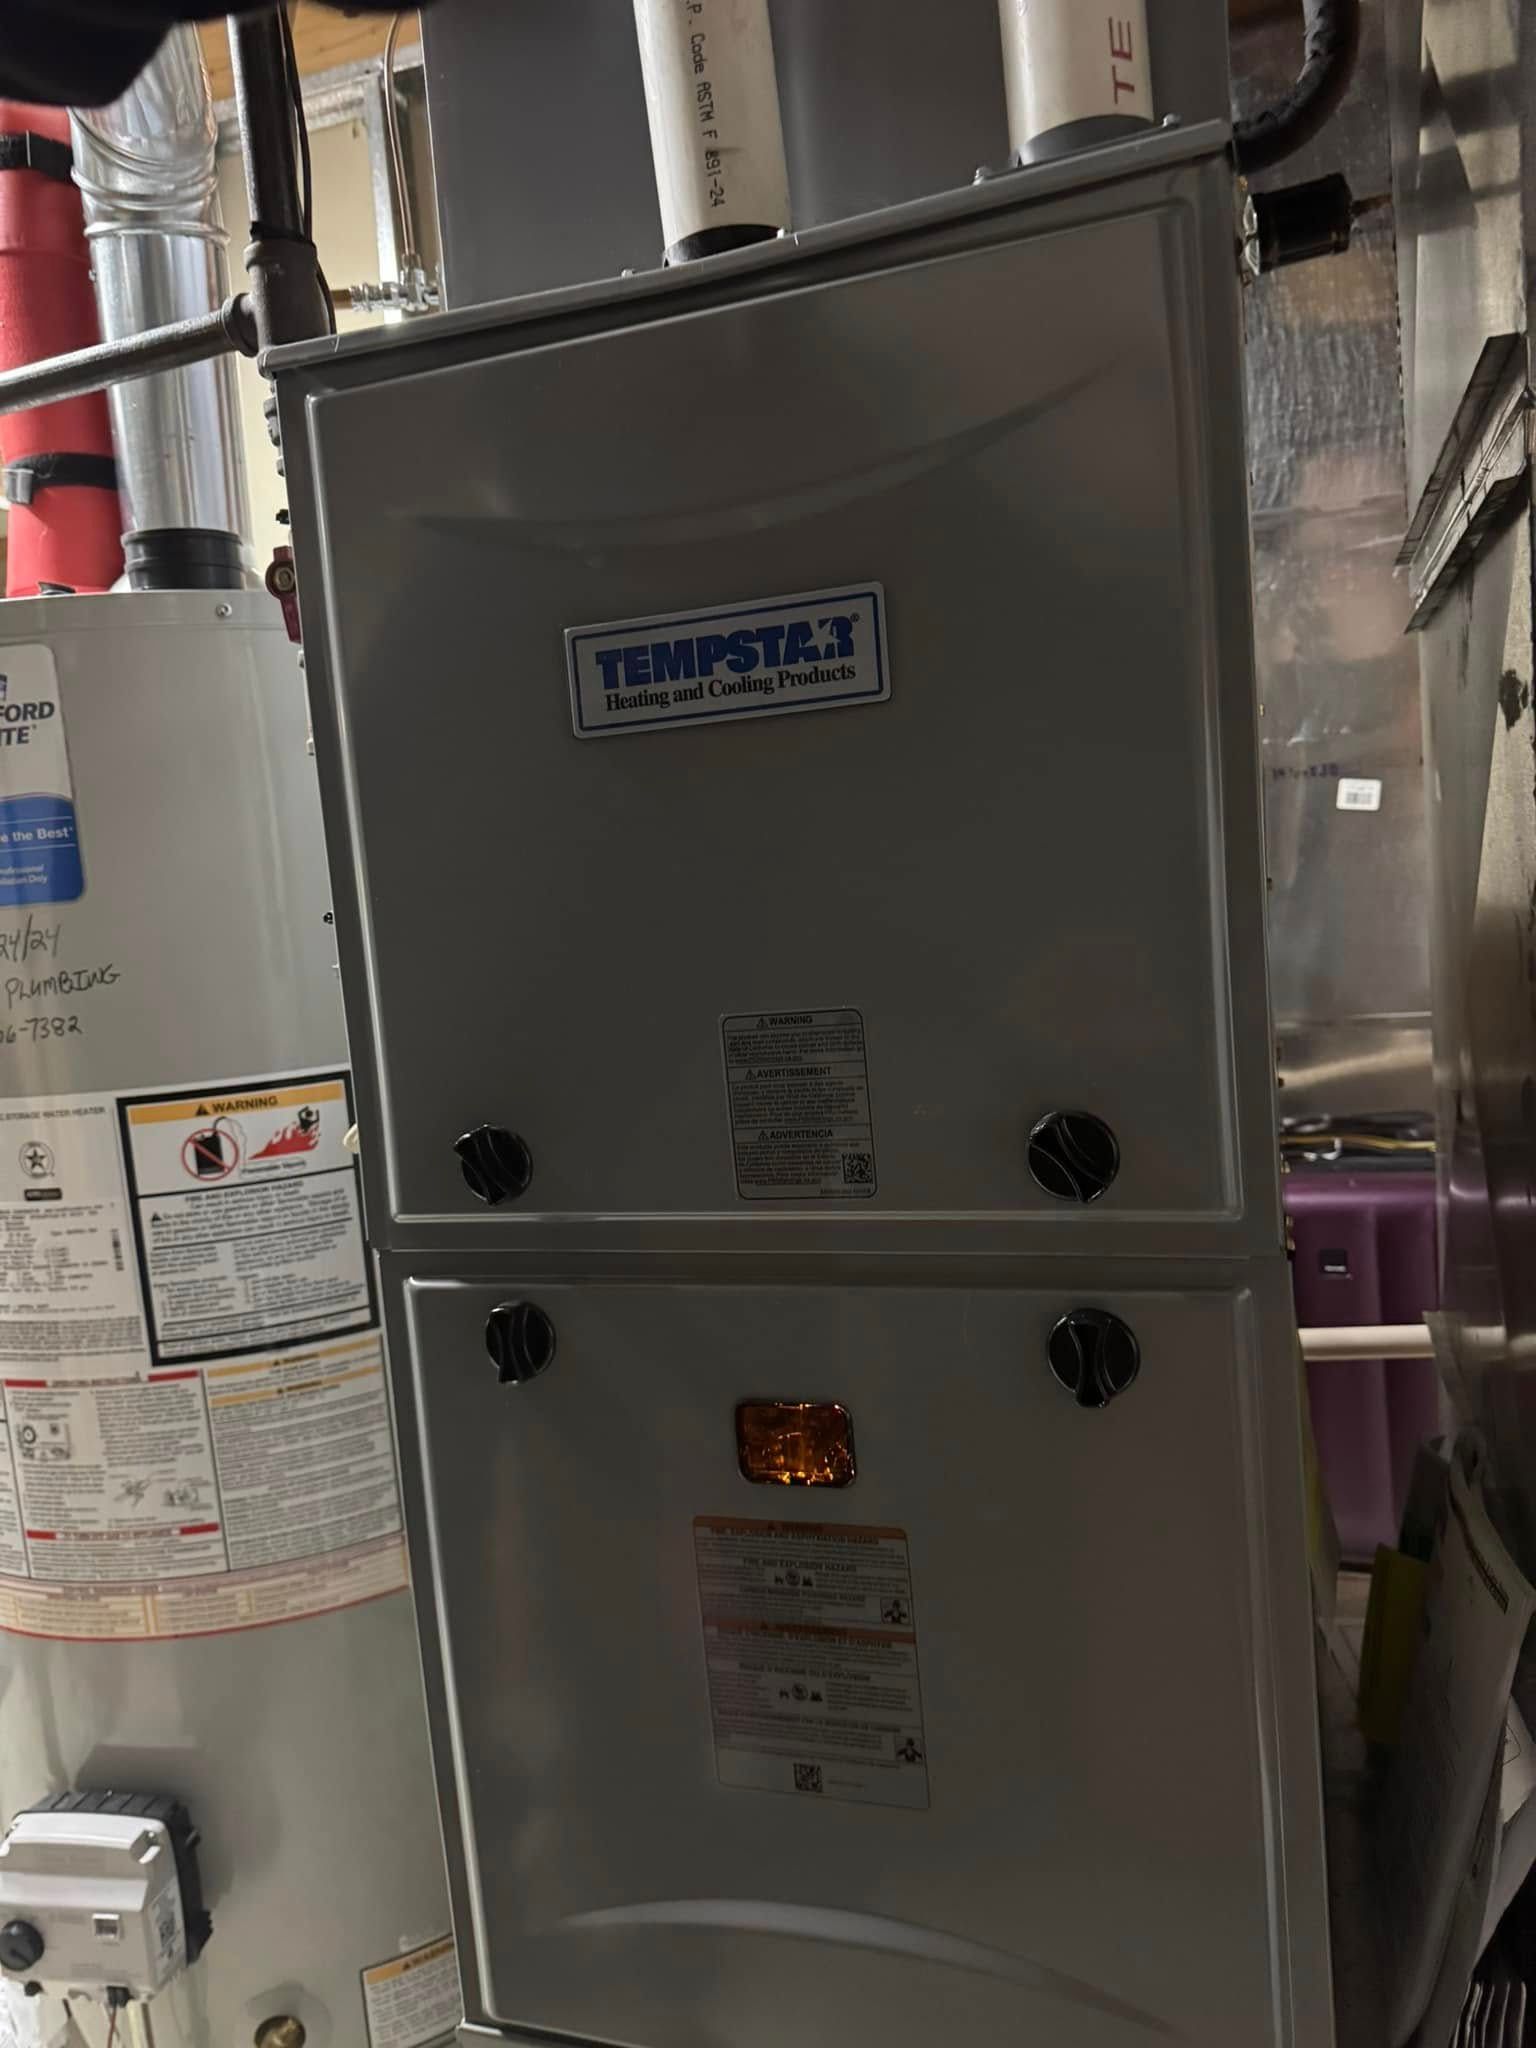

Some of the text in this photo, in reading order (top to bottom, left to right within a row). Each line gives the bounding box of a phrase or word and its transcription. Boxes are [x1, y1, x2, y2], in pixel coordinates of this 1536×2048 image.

[690, 33, 706, 74] Code
[696, 81, 715, 123] ASTM
[701, 129, 718, 140] F
[705, 150, 726, 208] 891-24
[605, 662, 856, 712] Heating and Cooling Products
[12, 831, 33, 842] the
[5, 963, 121, 1011] PLUMBING
[768, 1015, 813, 1027] WARNING
[756, 1066, 831, 1079] AVERTISSEMENT
[211, 1095, 279, 1115] WARNING
